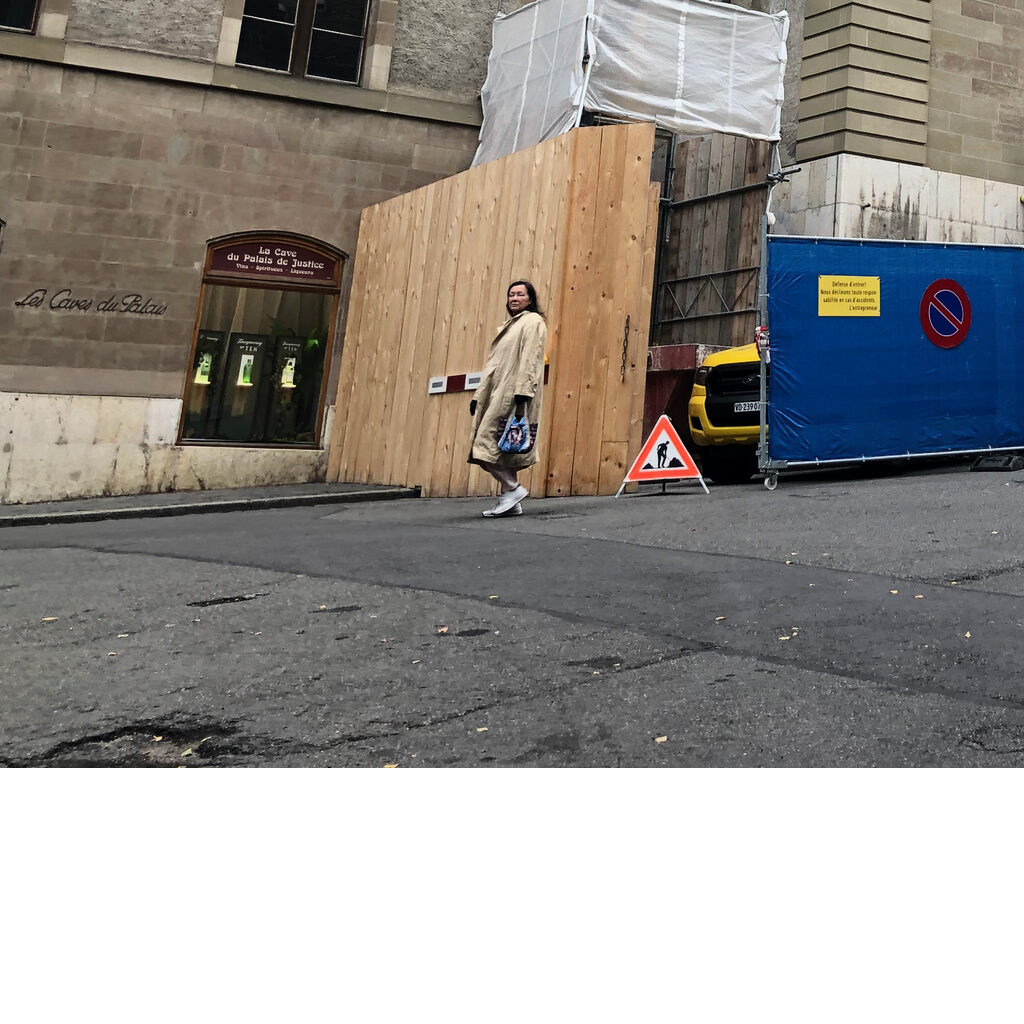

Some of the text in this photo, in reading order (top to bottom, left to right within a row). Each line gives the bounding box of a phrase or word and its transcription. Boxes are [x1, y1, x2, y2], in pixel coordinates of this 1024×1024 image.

[258, 246, 298, 258] La Cave
[227, 253, 325, 270] du Palais de Justice
[15, 288, 168, 316] Les Caves du Palais
